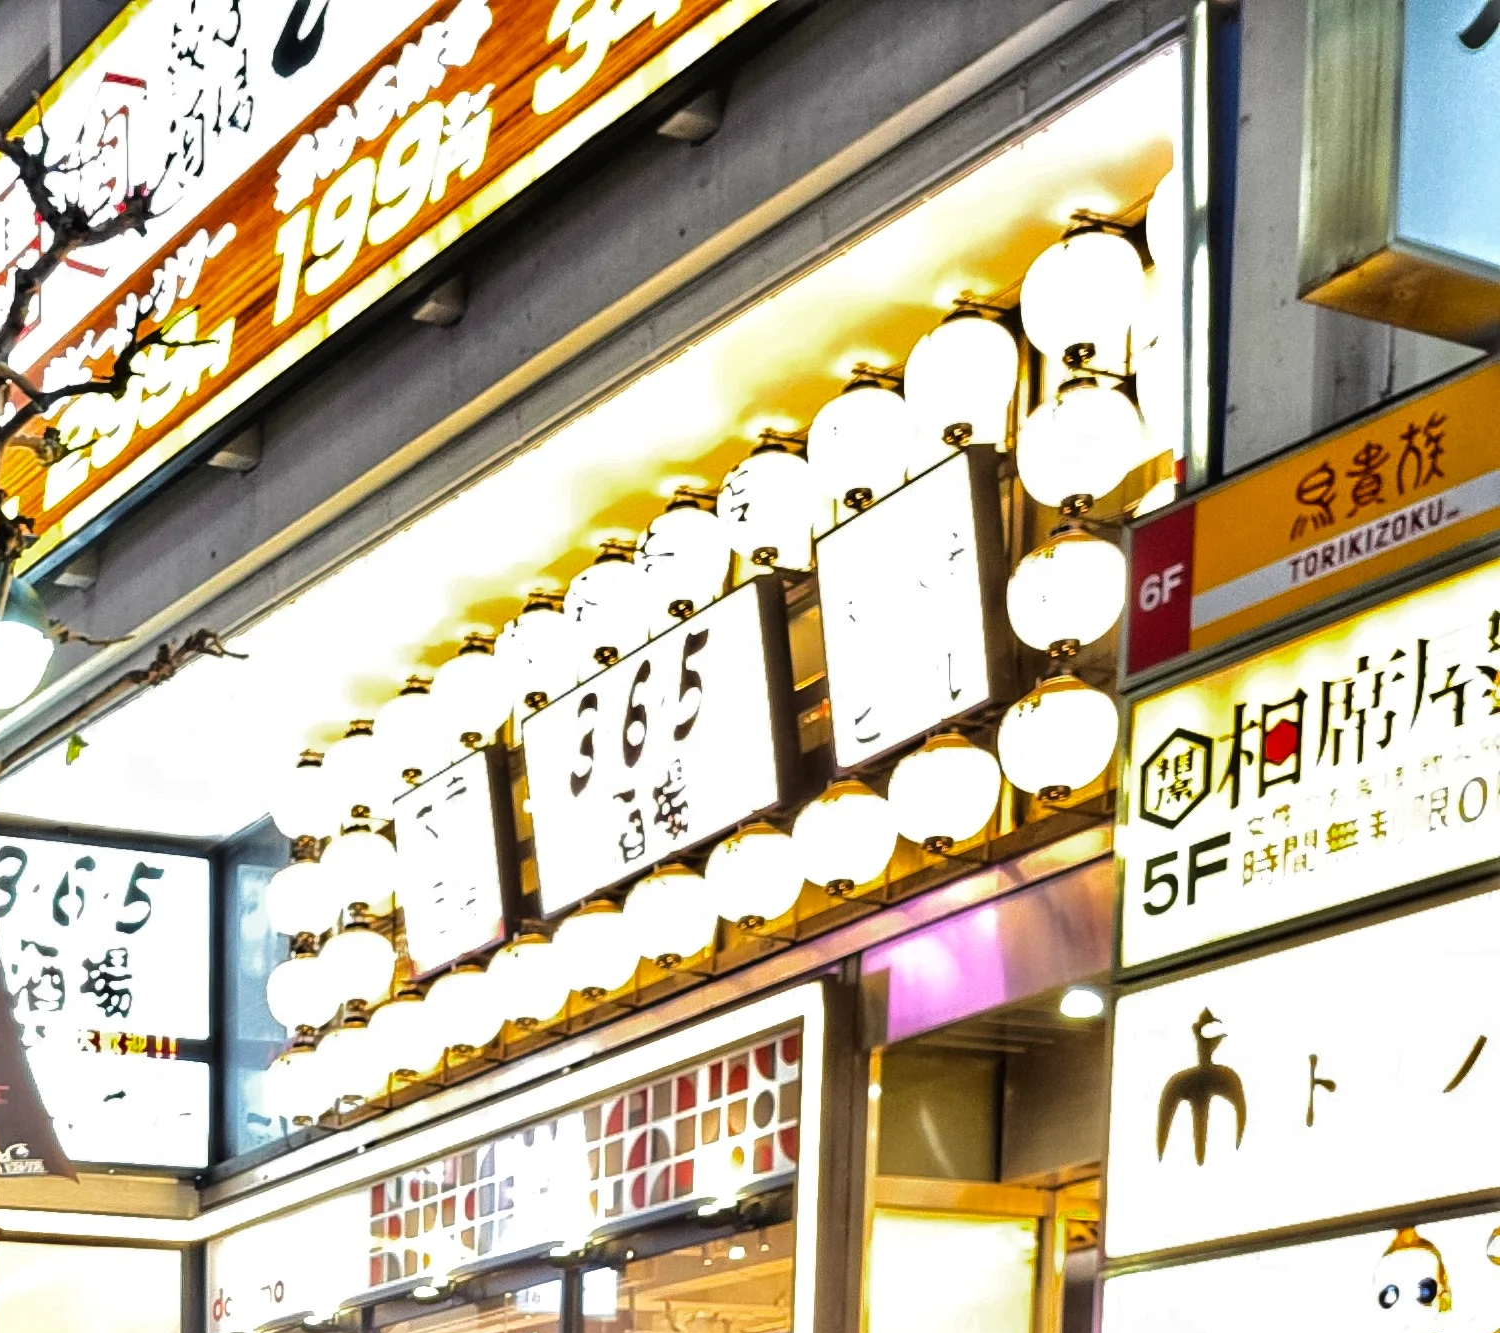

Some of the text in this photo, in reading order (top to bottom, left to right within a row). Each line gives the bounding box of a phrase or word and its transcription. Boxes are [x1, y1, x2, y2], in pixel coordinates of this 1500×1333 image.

[1288, 499, 1445, 585] TORIKIZOKU
[1140, 562, 1185, 612] 6F
[1142, 831, 1232, 916] 5F
